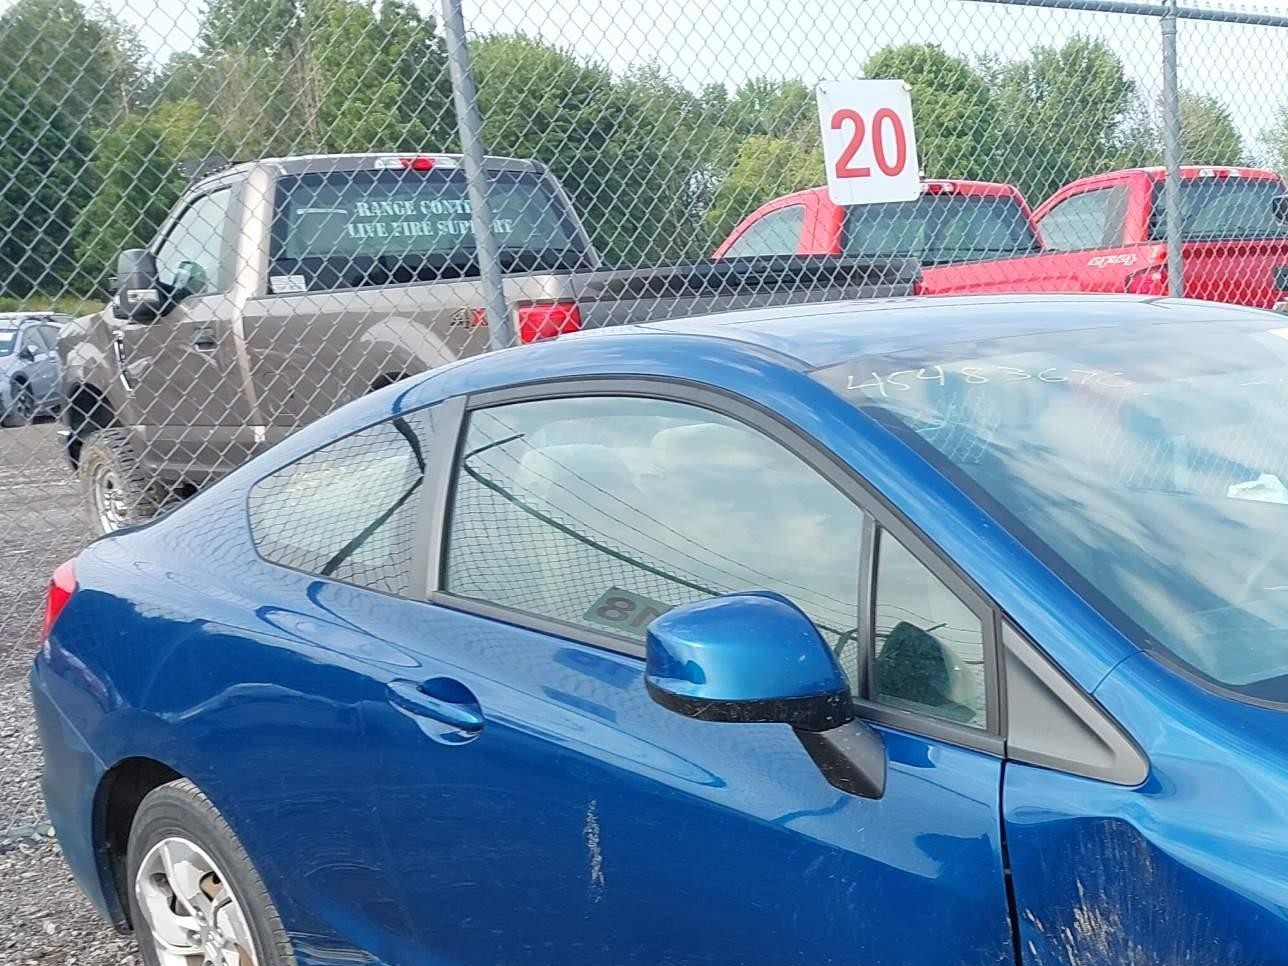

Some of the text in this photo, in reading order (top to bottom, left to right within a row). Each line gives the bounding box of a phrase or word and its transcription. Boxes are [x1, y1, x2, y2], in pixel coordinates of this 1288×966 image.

[831, 107, 907, 178] 20
[355, 201, 416, 216] RANGE
[347, 219, 512, 238] LIVE FIRE SUPRT
